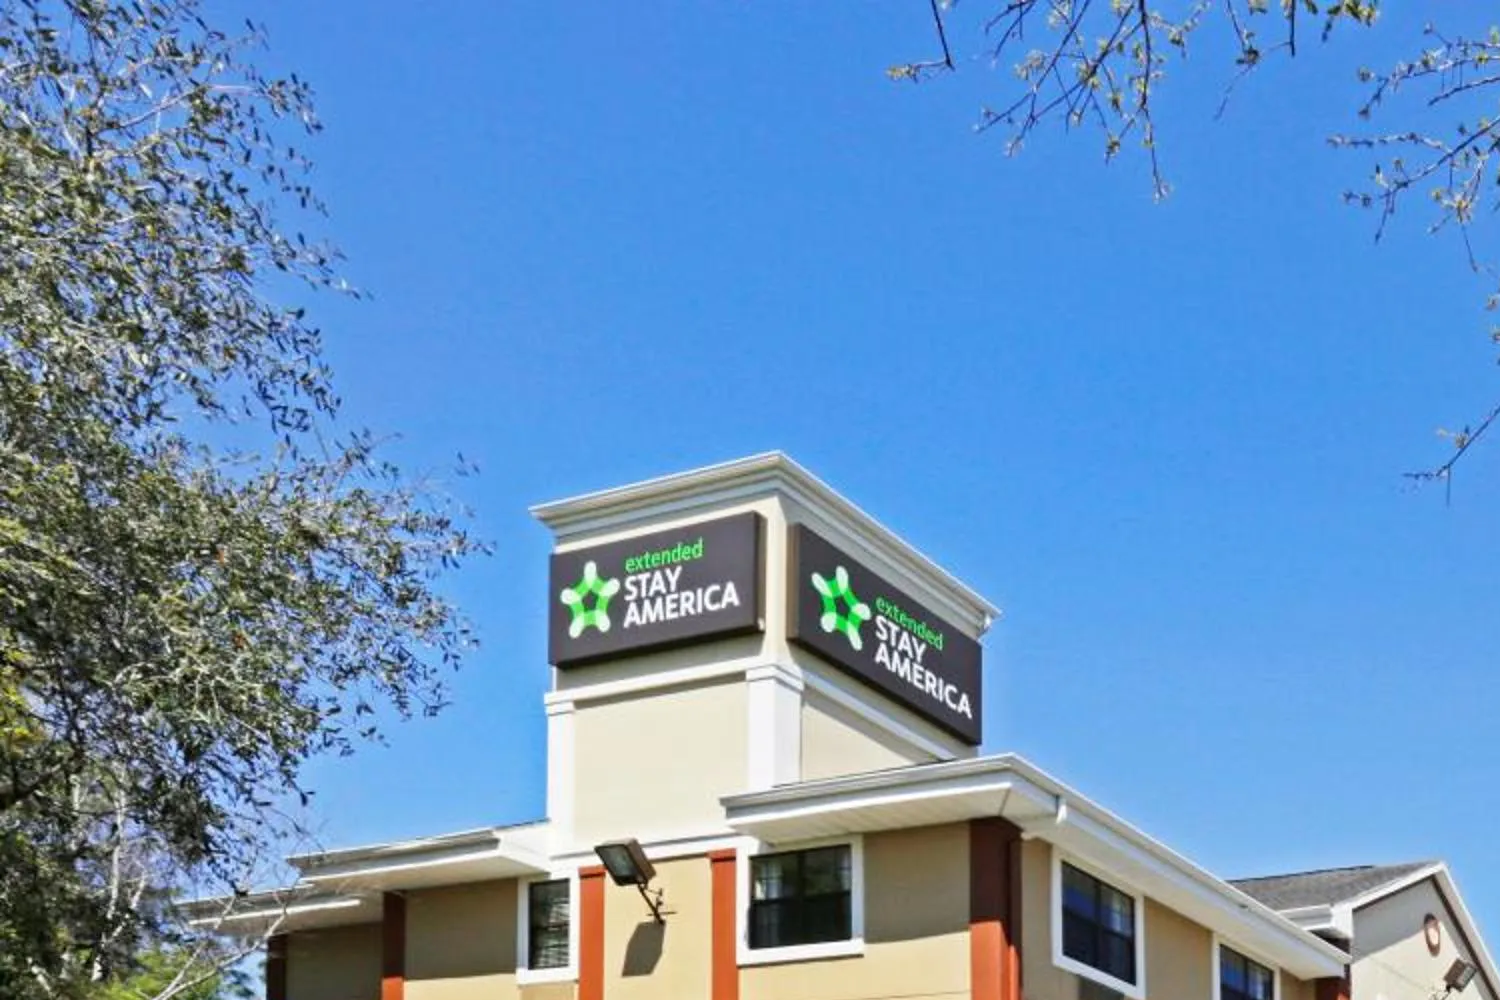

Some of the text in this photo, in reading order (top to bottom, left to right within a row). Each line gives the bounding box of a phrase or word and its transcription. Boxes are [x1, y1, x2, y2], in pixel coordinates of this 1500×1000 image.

[625, 538, 703, 573] extended
[623, 582, 739, 628] AMERICA
[624, 565, 682, 600] STAY
[875, 616, 926, 662] STAY
[876, 597, 943, 650] extended
[875, 643, 972, 719] AMERICA
